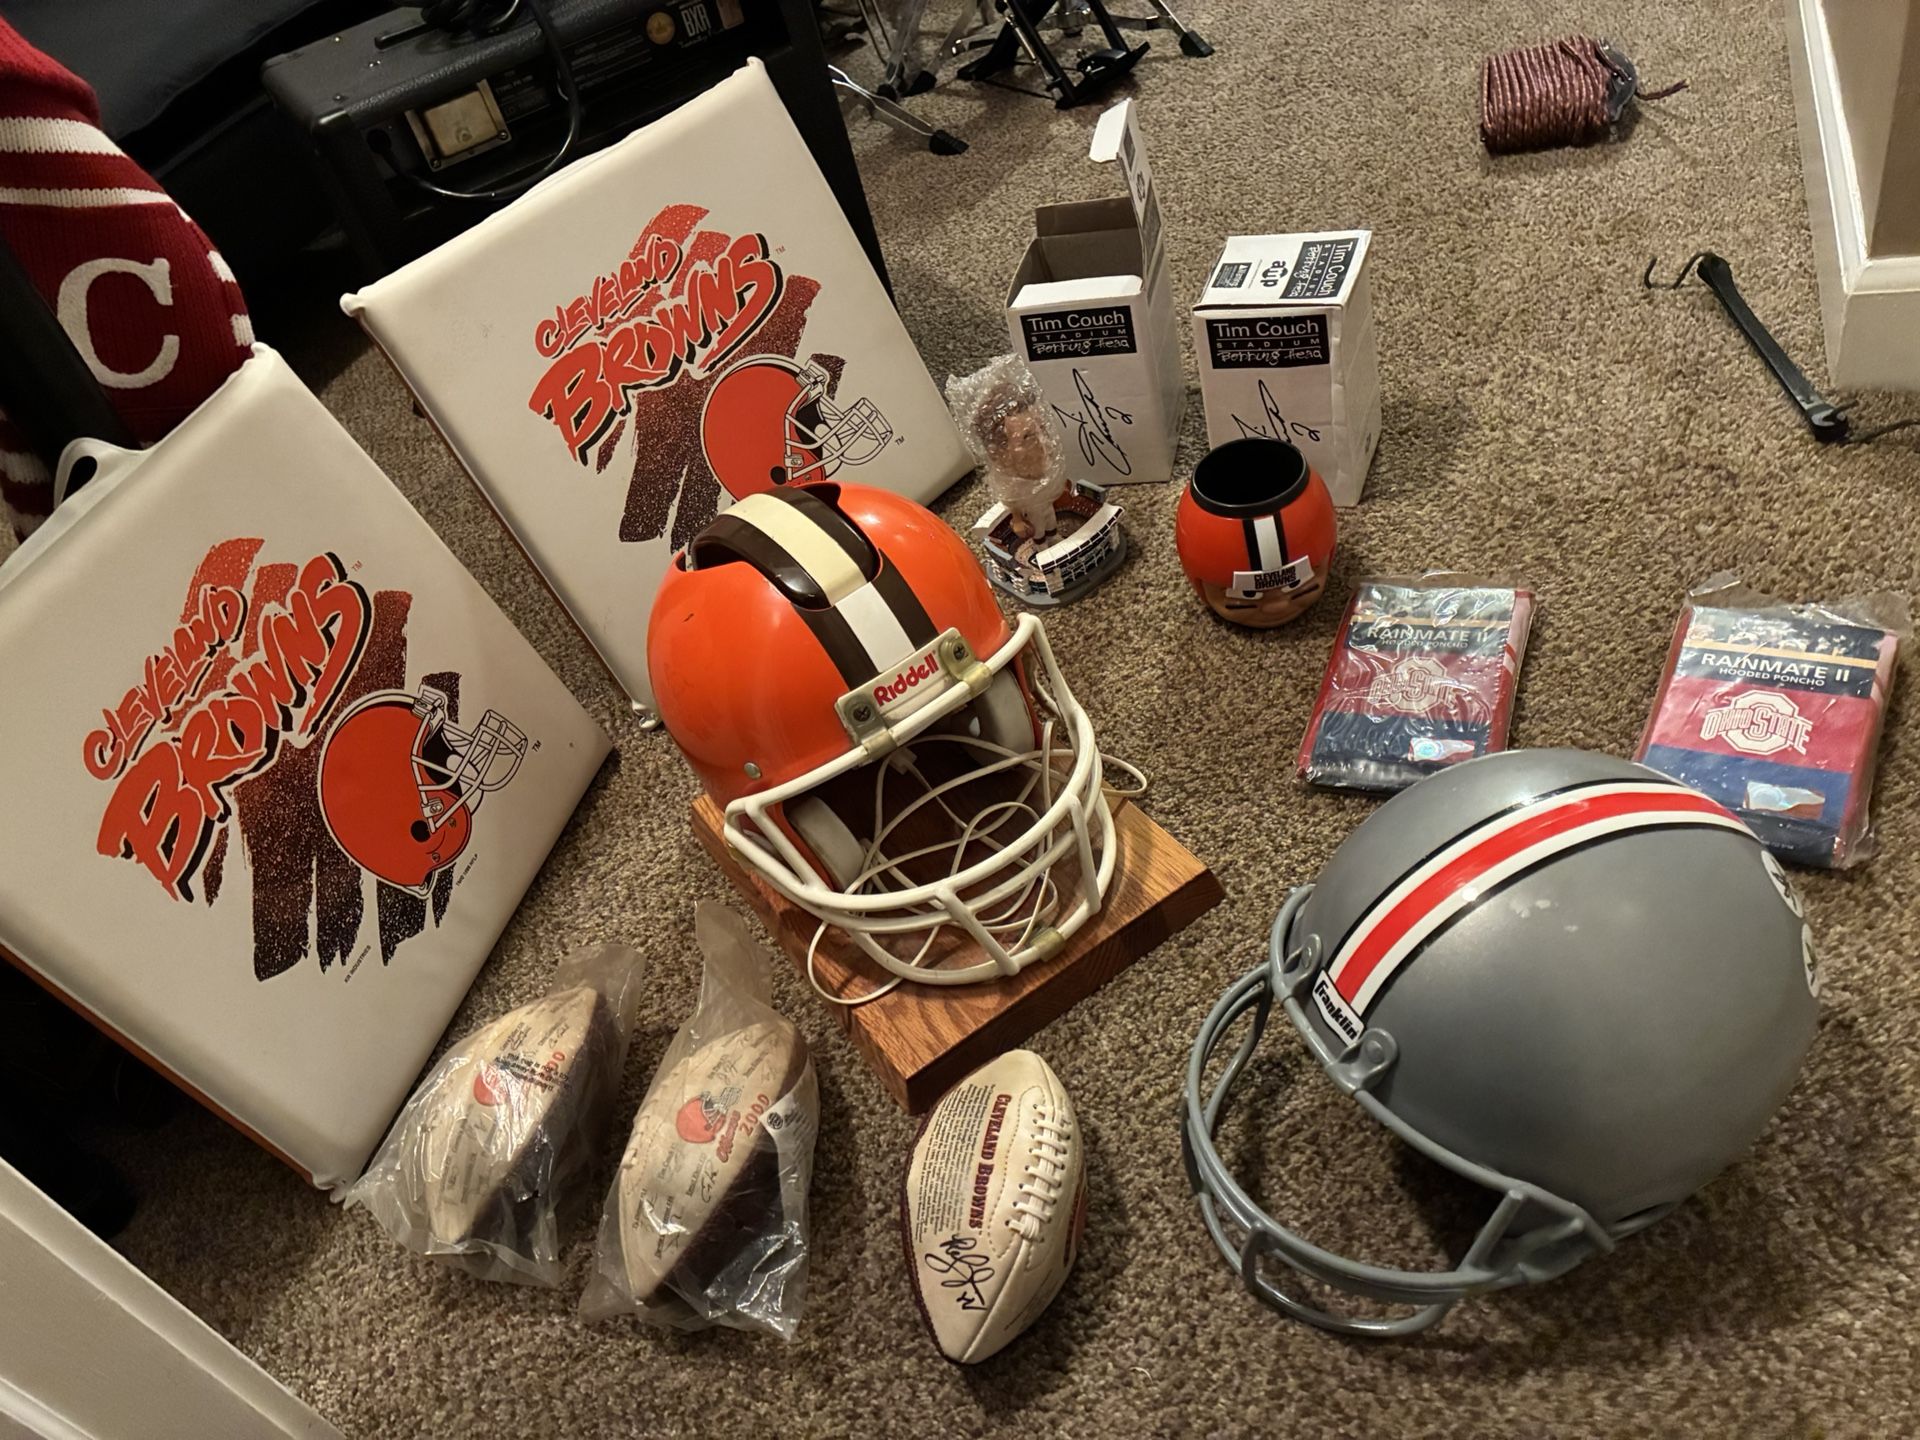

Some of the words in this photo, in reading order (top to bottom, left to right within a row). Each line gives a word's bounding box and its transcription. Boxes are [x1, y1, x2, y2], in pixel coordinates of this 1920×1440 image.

[1332, 241, 1353, 263] Tim
[1318, 265, 1345, 296] Couch
[534, 234, 683, 359] CLEVELAND
[57, 257, 180, 389] C
[1027, 317, 1062, 332] Tim
[1066, 310, 1125, 328] Couch
[1031, 328, 1127, 342] STADIUM
[1212, 323, 1250, 337] Tim
[1256, 319, 1319, 336] Couch
[529, 233, 783, 466] BROWNS
[1216, 338, 1320, 349] STADIUM
[1254, 566, 1296, 580] CLEVELAND
[1255, 575, 1297, 590] BROWNS
[1367, 627, 1470, 641] RAINMATE
[83, 583, 248, 780] CLEVELAND
[873, 652, 940, 707] Riddell
[1701, 653, 1828, 679] RAINMATE
[1835, 669, 1850, 682] II
[1719, 667, 1769, 681] HOODED
[1773, 673, 1825, 687] PONCHO
[97, 552, 373, 903] BROWNS
[1314, 979, 1358, 1040] Franklin
[739, 1094, 770, 1137] 2000
[981, 1093, 1012, 1160] CLEVELAND
[969, 1163, 994, 1229] BROWNS
